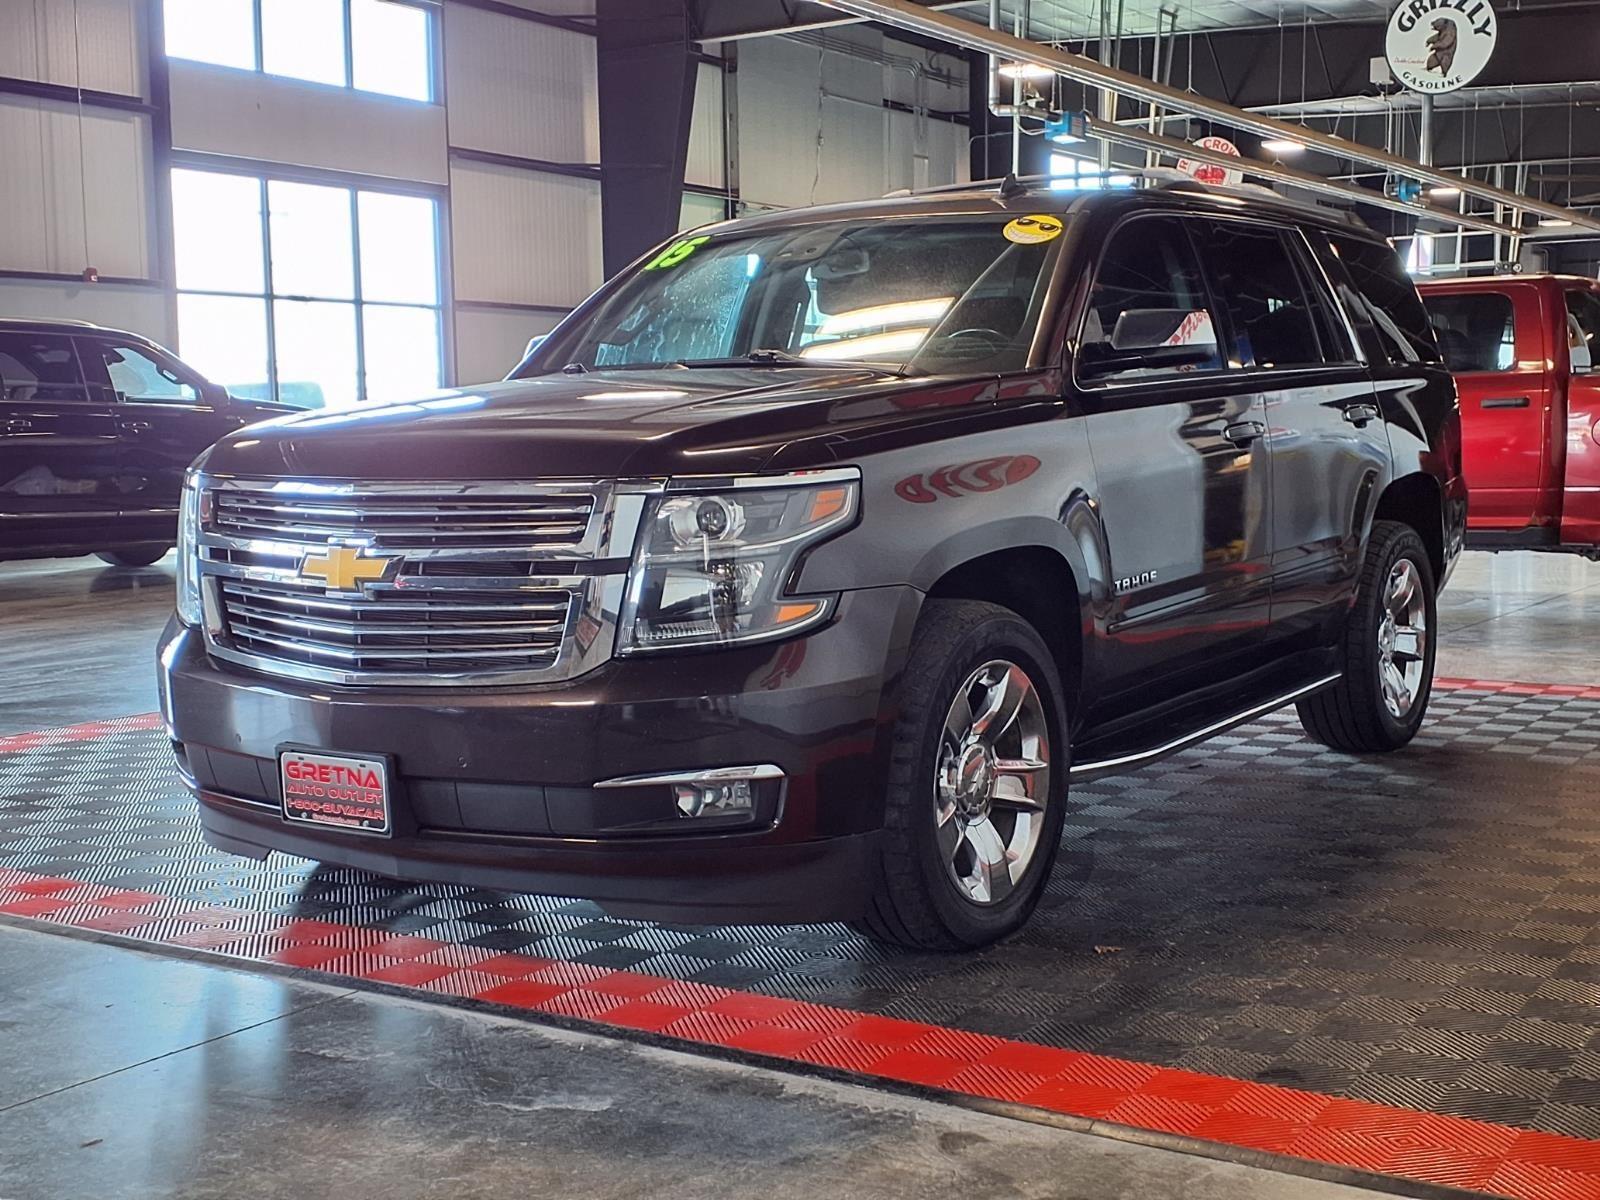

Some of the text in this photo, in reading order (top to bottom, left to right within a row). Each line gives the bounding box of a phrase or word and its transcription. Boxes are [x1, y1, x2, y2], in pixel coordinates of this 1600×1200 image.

[1402, 71, 1463, 89] GASOLINE
[1114, 570, 1158, 591] TAHOE
[286, 761, 382, 790] GRETNA
[287, 783, 383, 804] AUTO OUTLET
[287, 798, 384, 820] 1-800-BUYACAR
